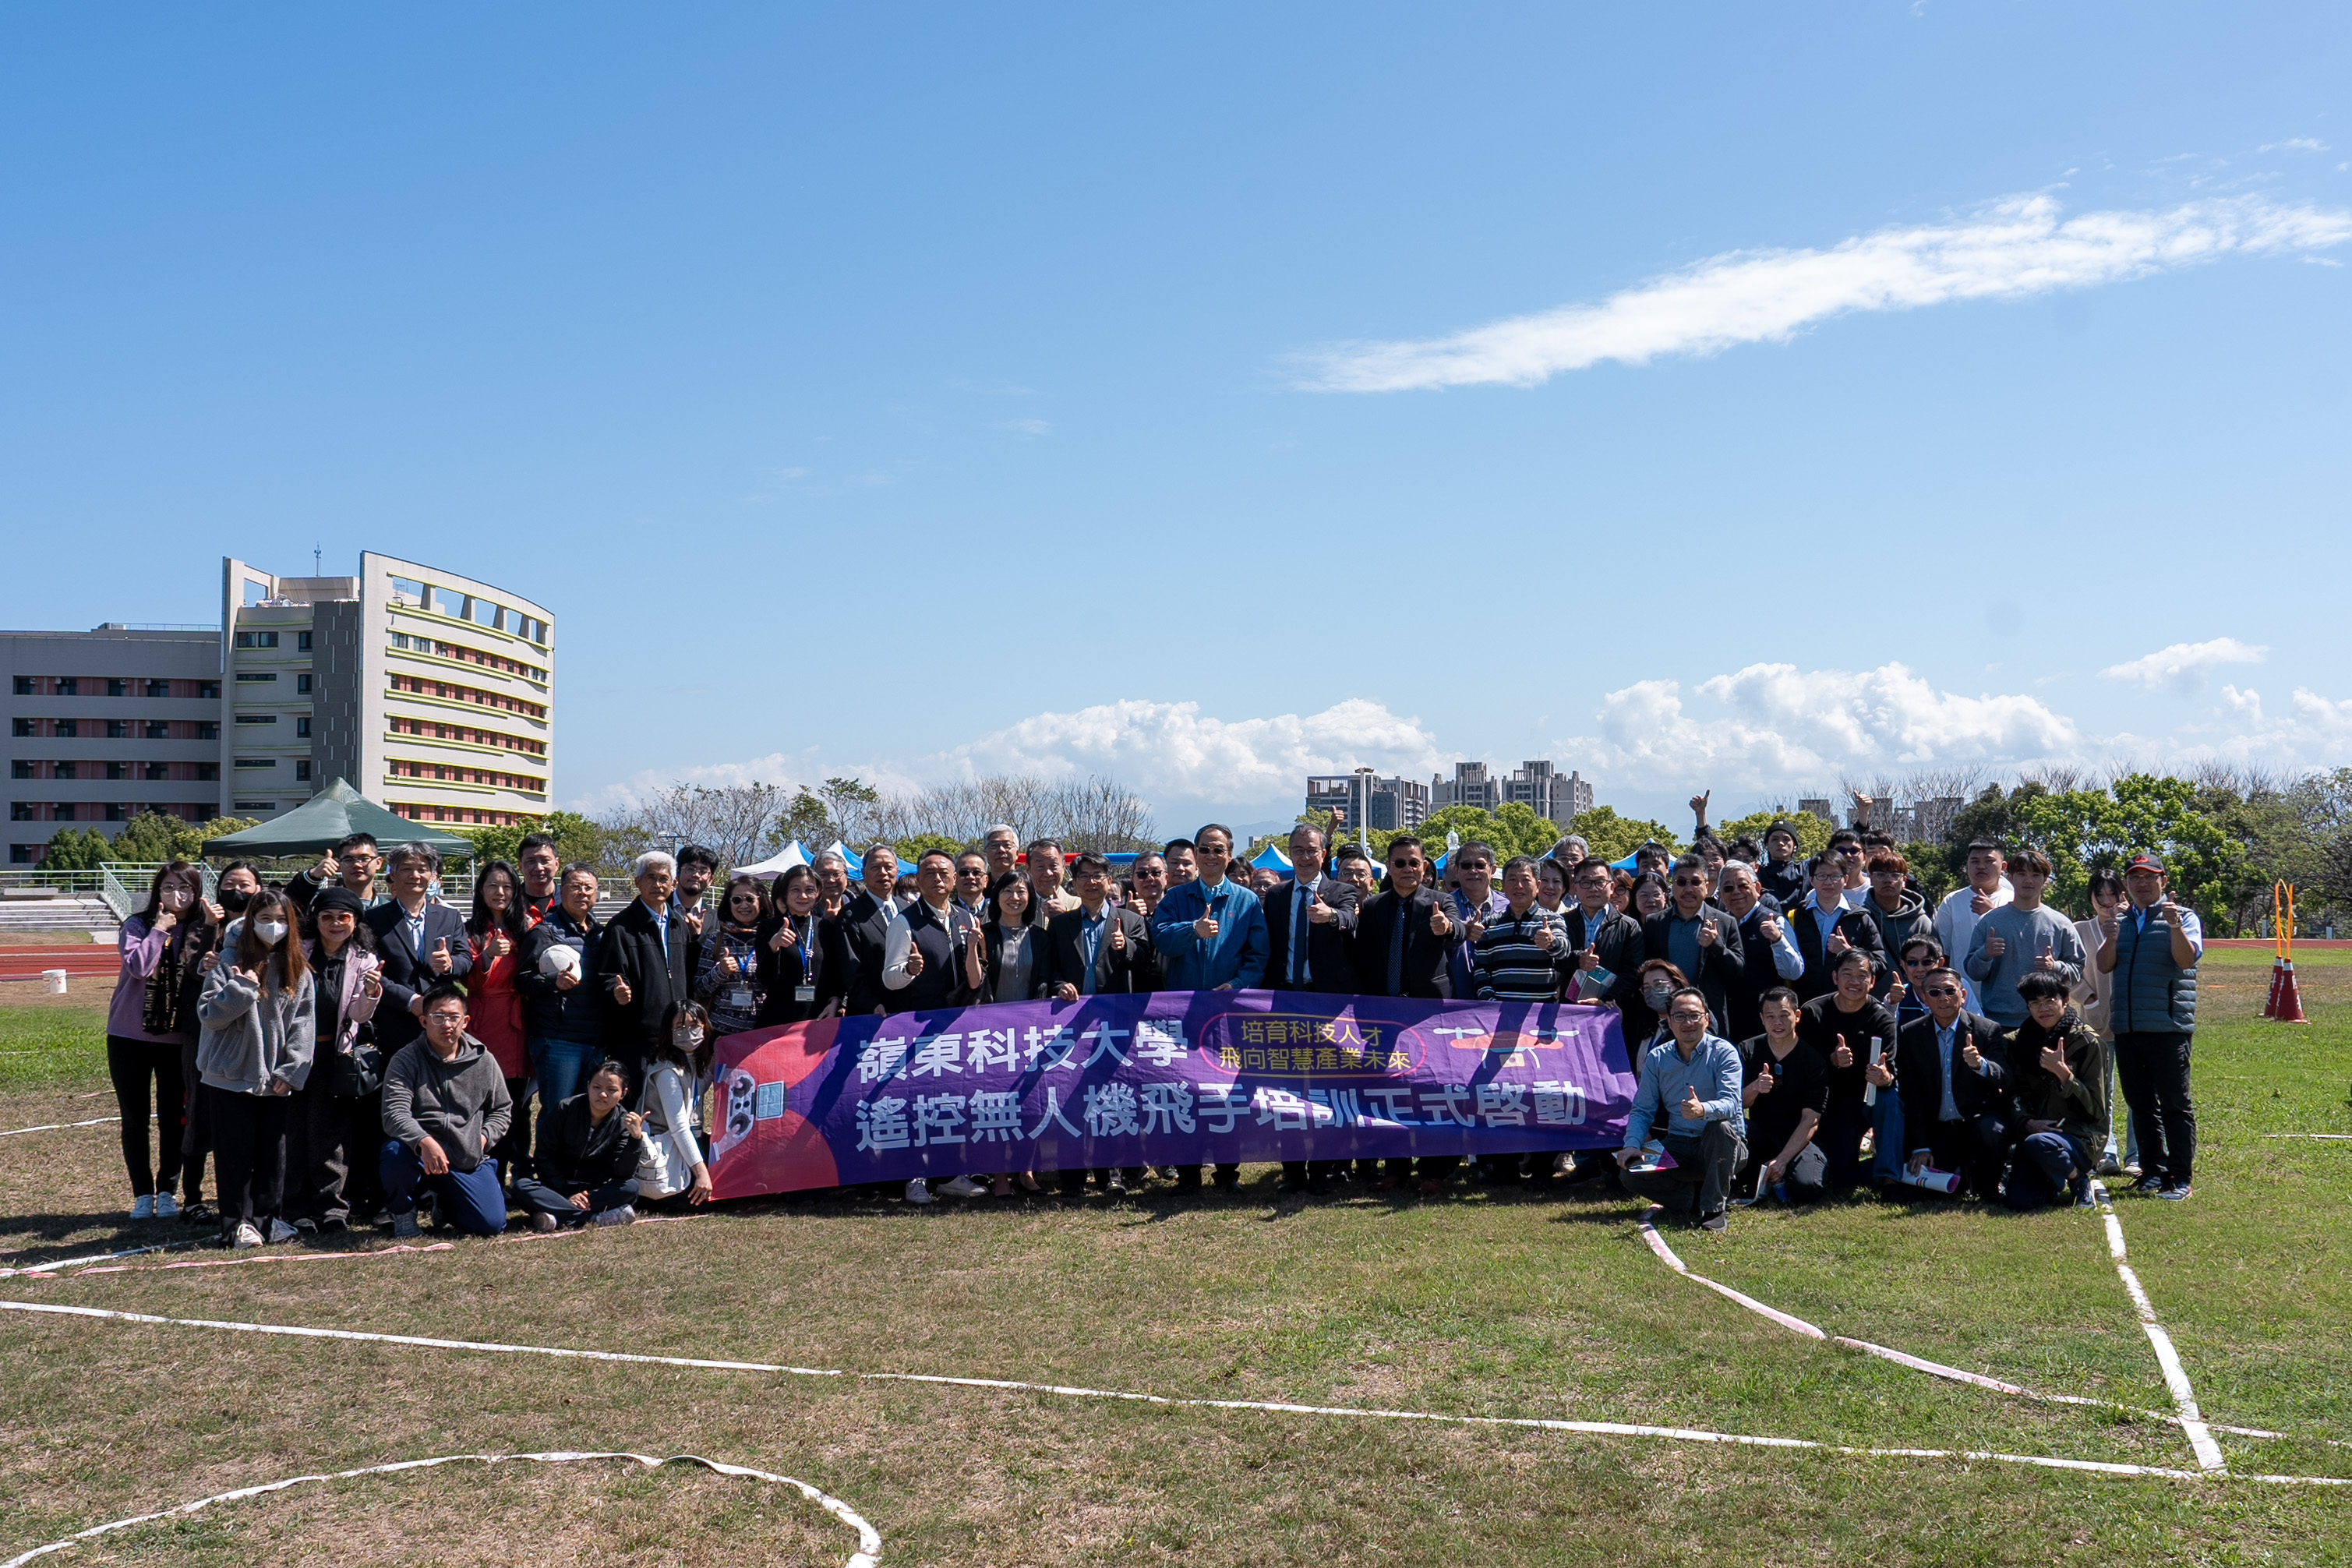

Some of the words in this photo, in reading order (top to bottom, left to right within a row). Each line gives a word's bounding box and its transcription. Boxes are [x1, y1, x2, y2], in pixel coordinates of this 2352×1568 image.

[1241, 1019, 1383, 1047] 培育科技人才
[856, 1019, 1188, 1084] 嶺東科技大學
[1220, 1046, 1411, 1072] 飛向智慧產業未來
